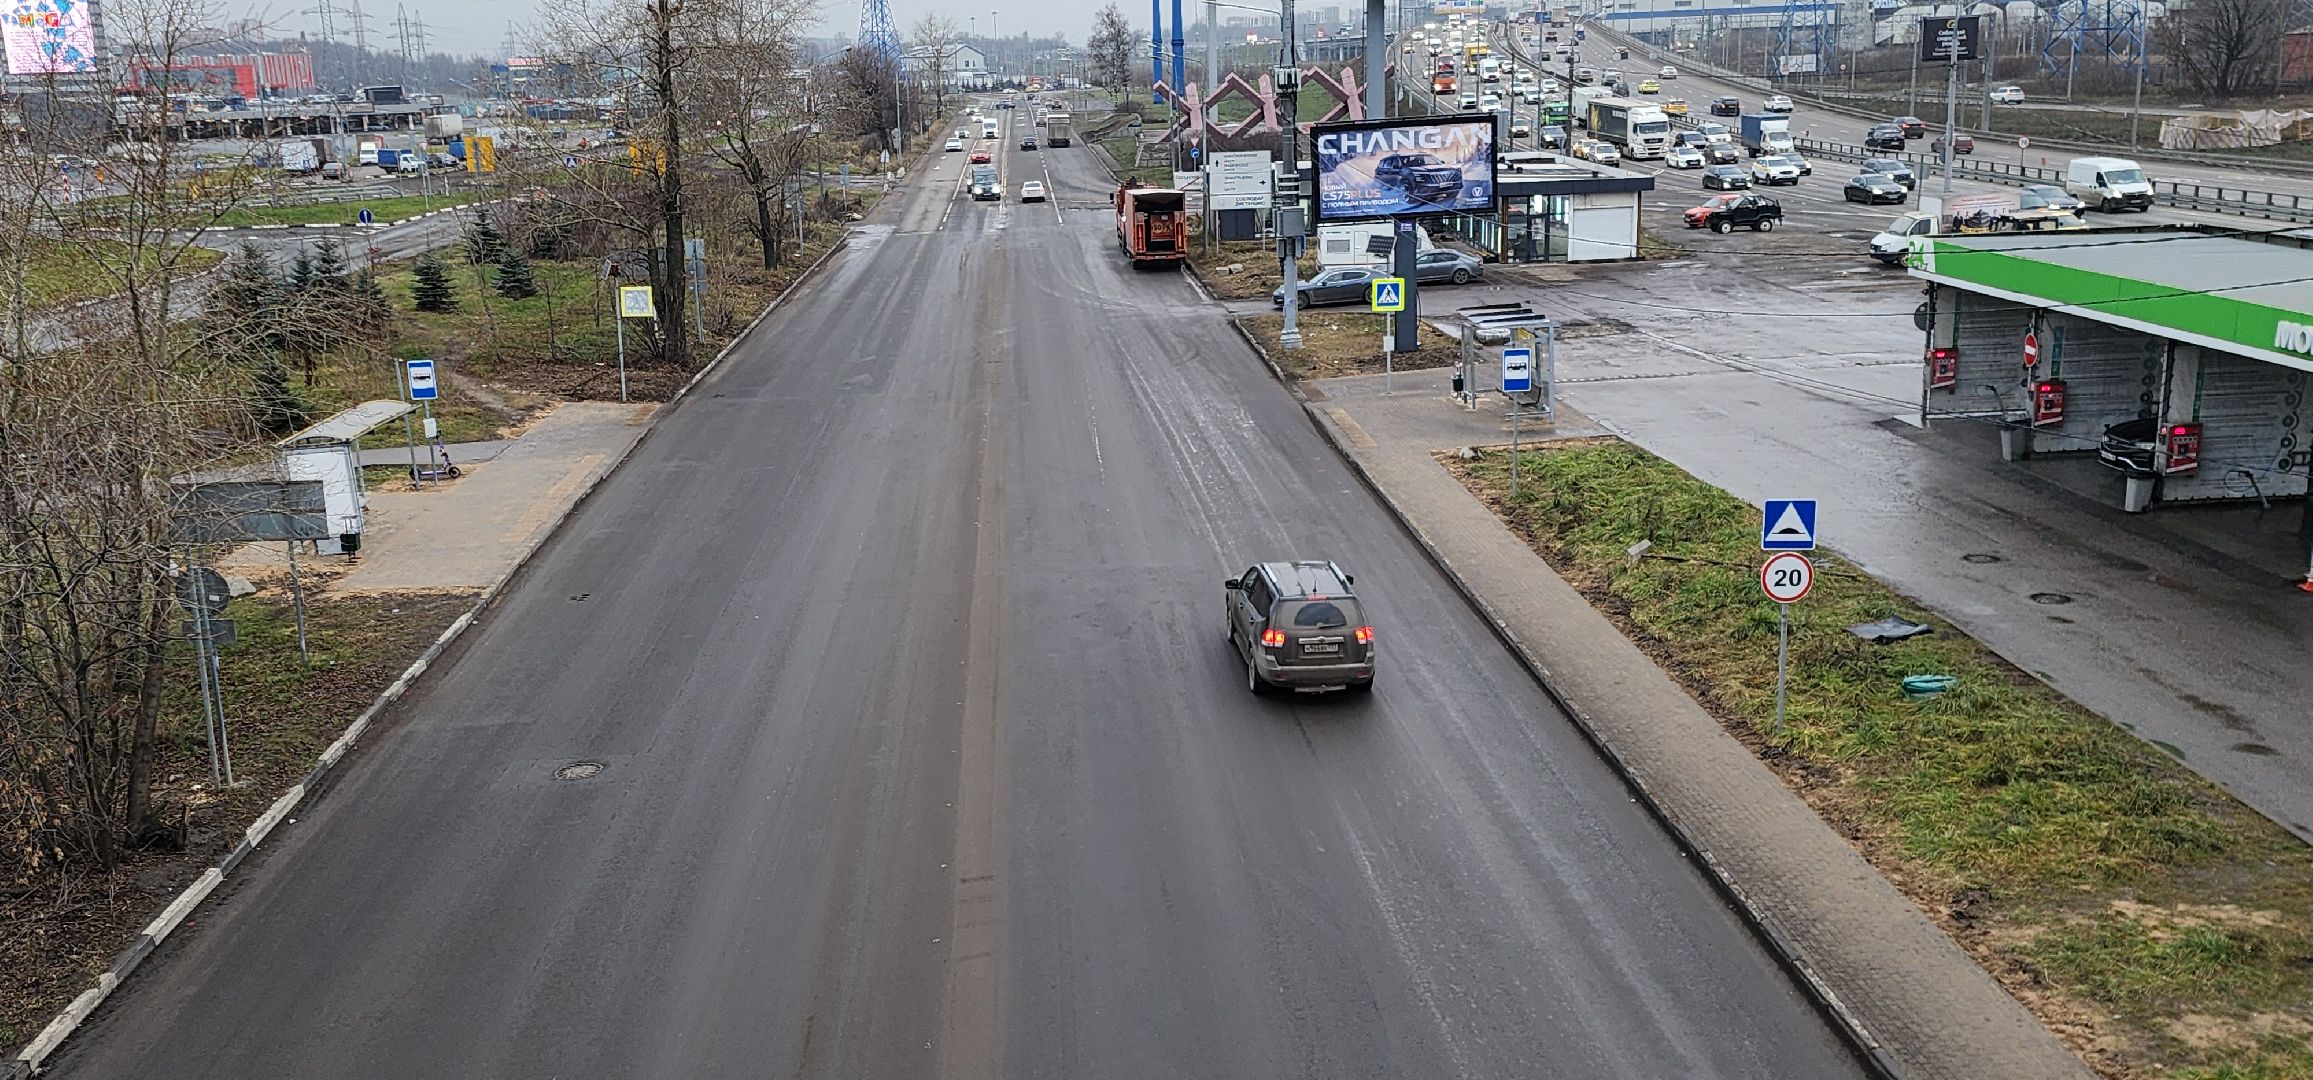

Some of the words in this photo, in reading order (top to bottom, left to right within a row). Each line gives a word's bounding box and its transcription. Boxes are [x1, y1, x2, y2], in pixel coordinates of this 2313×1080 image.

[1318, 123, 1492, 155] CHANGAN
[2274, 320, 2313, 355] МО
[1773, 569, 1802, 587] 20
